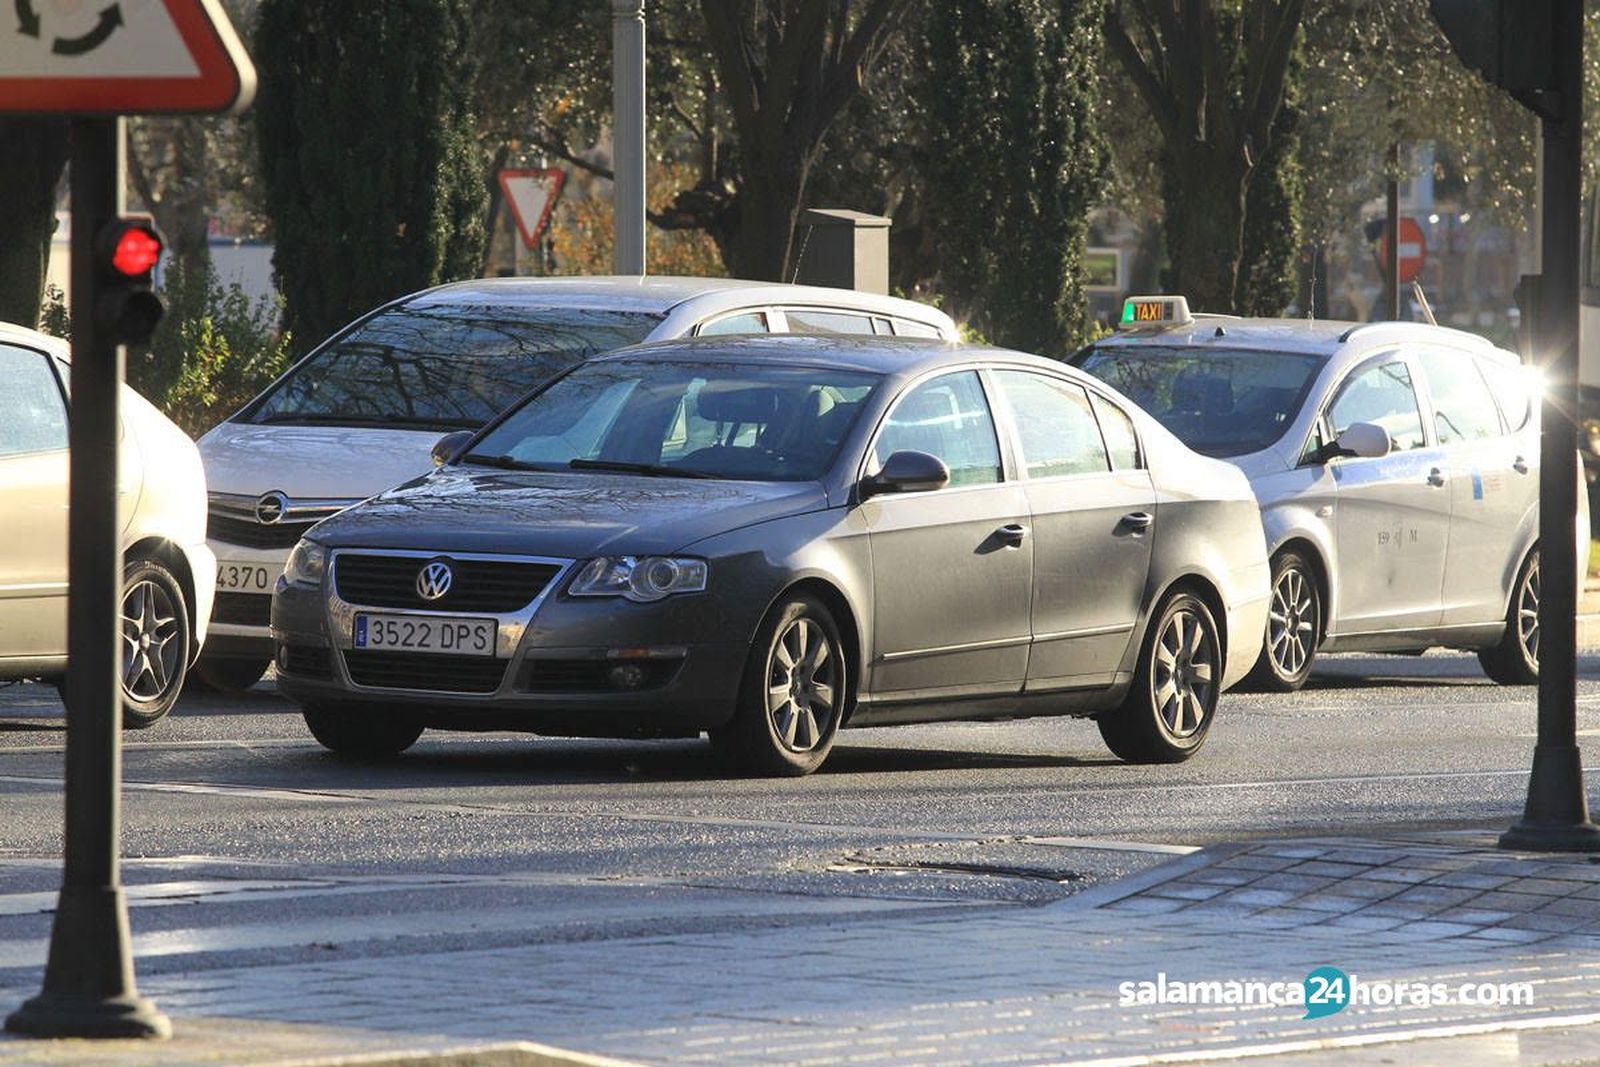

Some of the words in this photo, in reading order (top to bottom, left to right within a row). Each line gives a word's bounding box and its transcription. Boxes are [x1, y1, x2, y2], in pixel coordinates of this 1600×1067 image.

[1136, 303, 1161, 321] TAXI
[216, 565, 268, 589] 4370
[371, 620, 431, 648] 3522
[440, 623, 487, 651] DPS
